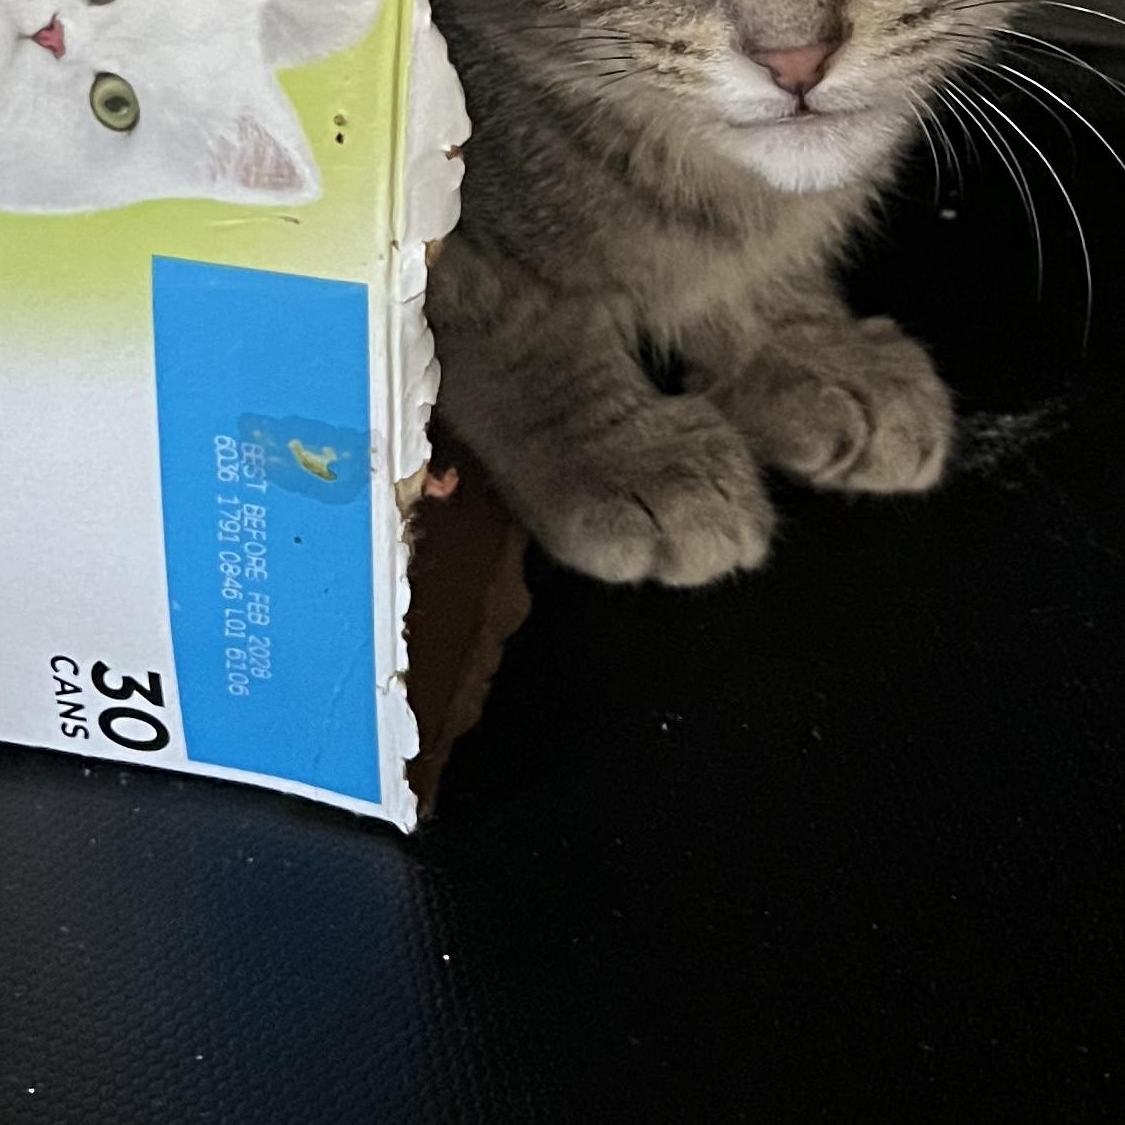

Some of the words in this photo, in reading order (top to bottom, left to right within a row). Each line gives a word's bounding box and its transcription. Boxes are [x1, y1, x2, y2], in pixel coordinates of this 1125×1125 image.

[241, 443, 266, 491] BEST
[243, 505, 268, 580] BEFORE
[248, 593, 270, 625] FEB
[50, 656, 88, 739] CANS
[89, 661, 171, 751] 30
